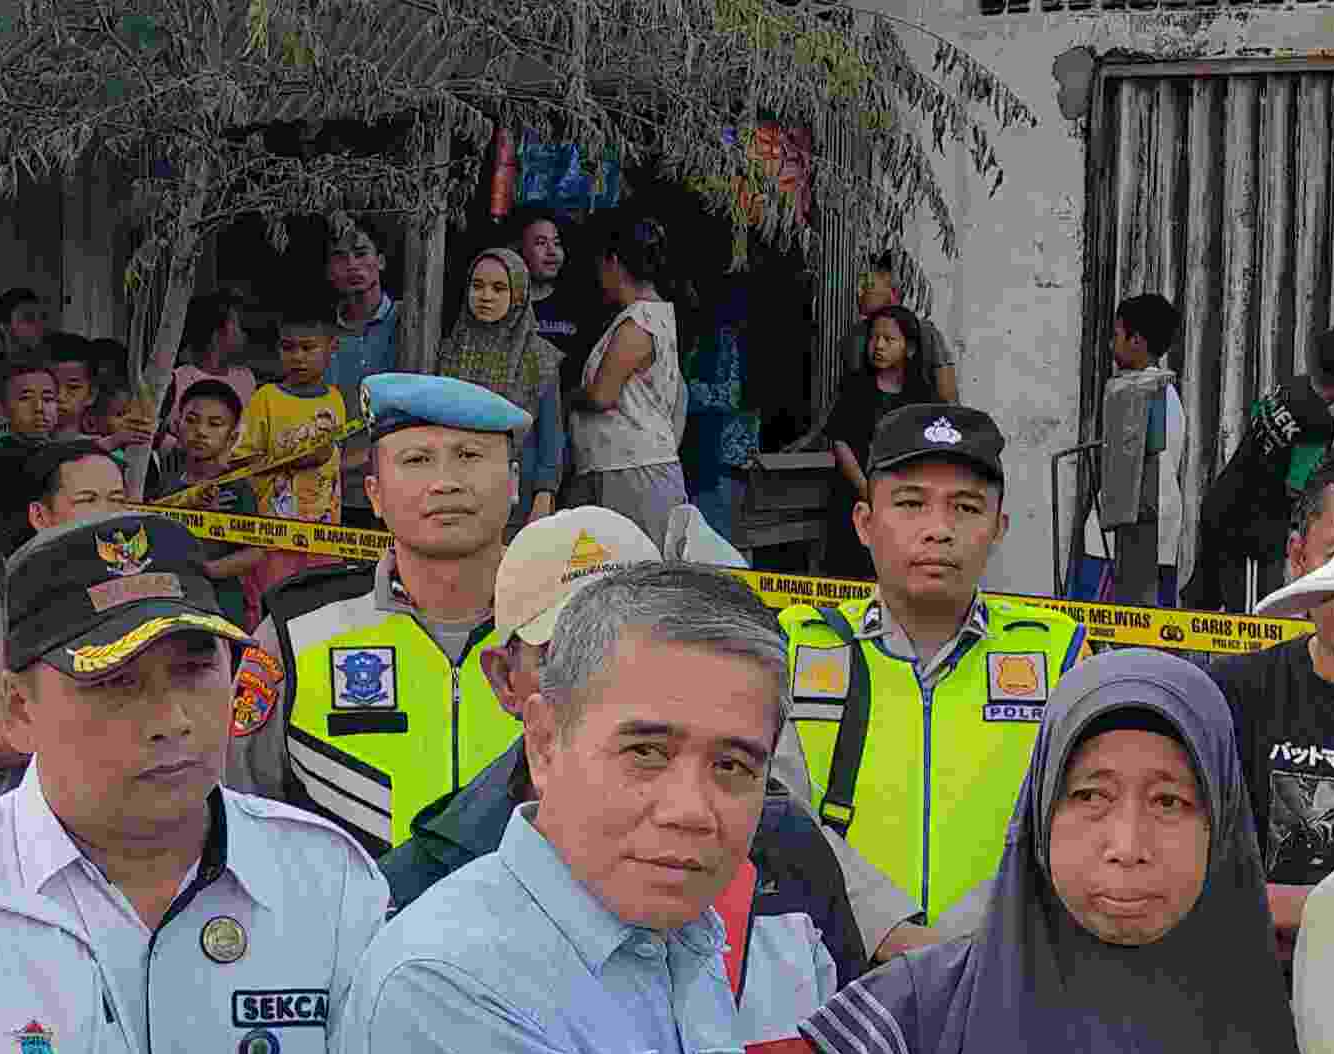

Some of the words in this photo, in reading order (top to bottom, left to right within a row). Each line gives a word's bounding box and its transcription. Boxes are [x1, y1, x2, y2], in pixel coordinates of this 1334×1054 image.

[759, 574, 814, 594] DILARANG
[816, 580, 874, 599] MELINTAS
[1088, 608, 1152, 629] MELINTAS
[1190, 616, 1233, 637] GARIS
[1237, 621, 1284, 641] POLISI
